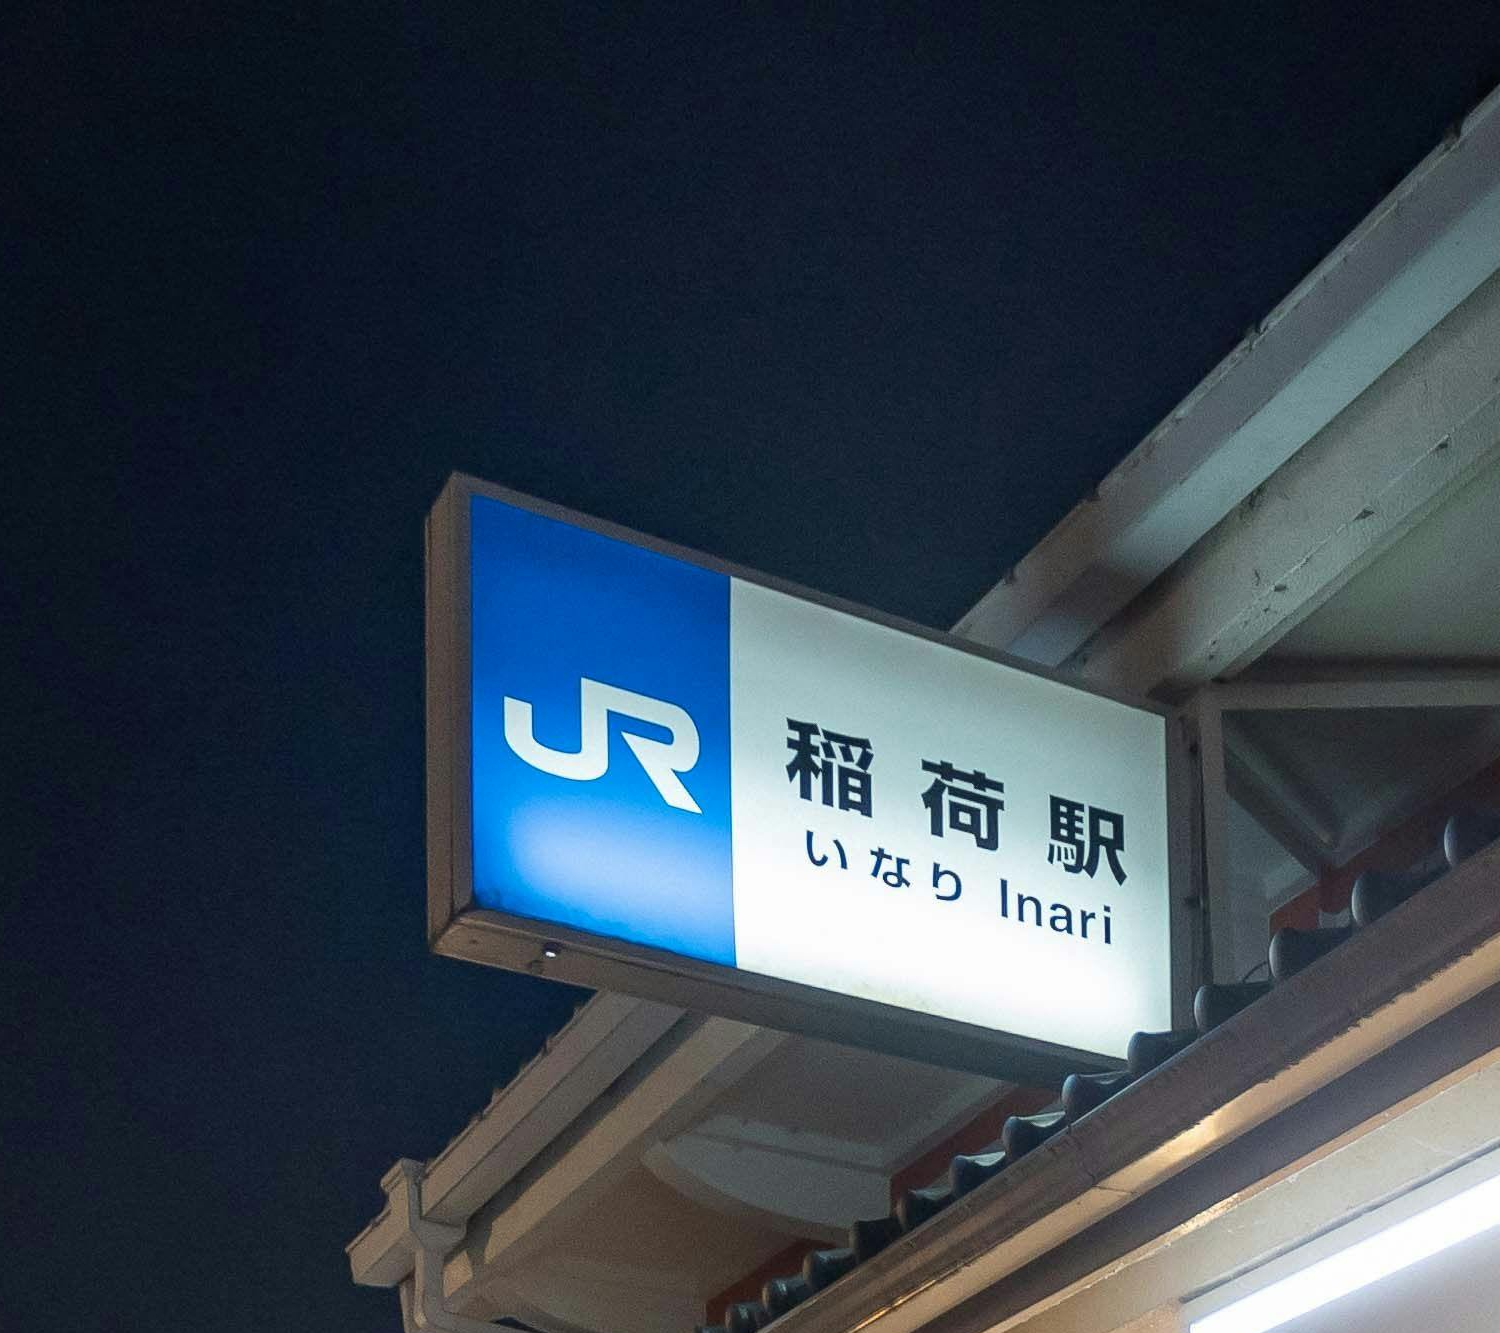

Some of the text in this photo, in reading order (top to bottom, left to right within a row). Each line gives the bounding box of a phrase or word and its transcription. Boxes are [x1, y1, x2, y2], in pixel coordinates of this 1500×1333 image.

[504, 677, 702, 814] JR
[784, 718, 1129, 886] 稲荷駅
[806, 829, 1113, 946] いなり Inari
